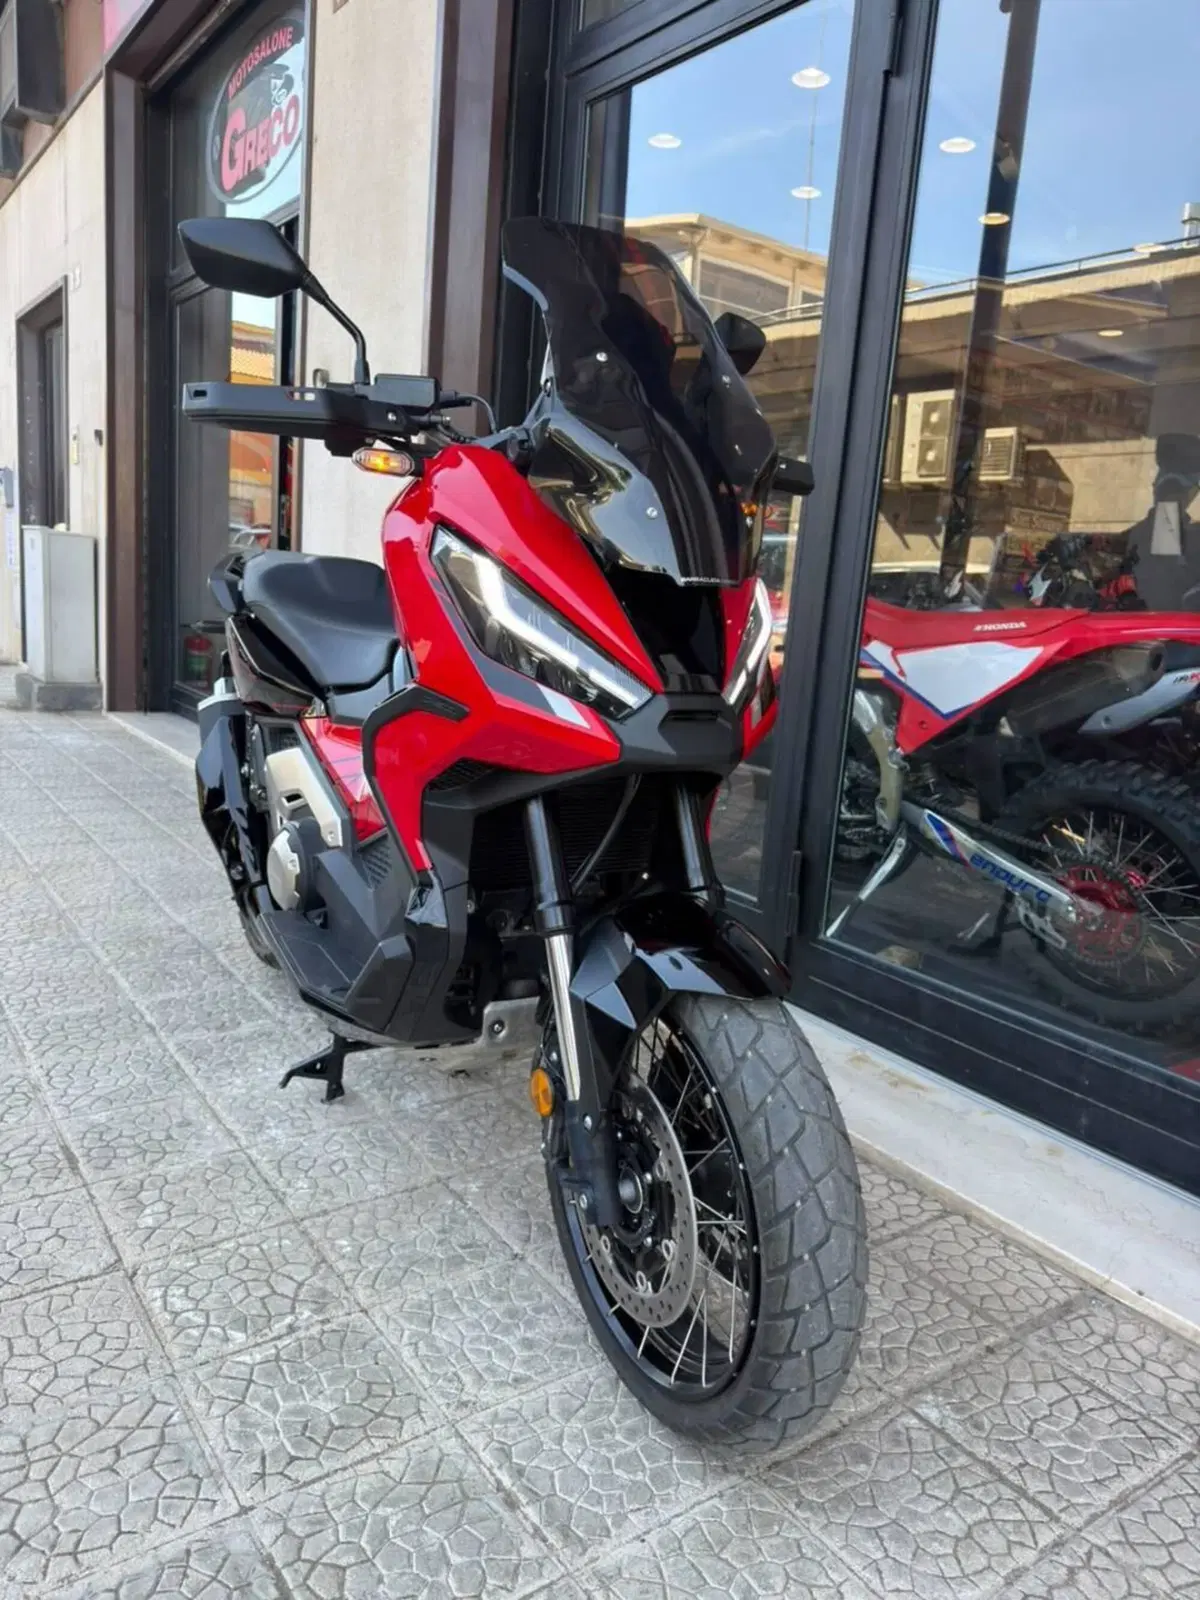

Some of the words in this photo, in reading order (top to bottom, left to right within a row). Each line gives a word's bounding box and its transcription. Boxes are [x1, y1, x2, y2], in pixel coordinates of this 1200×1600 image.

[228, 27, 293, 99] MOTOSALONE
[982, 621, 1027, 631] HONDA
[969, 853, 1052, 904] enduro
